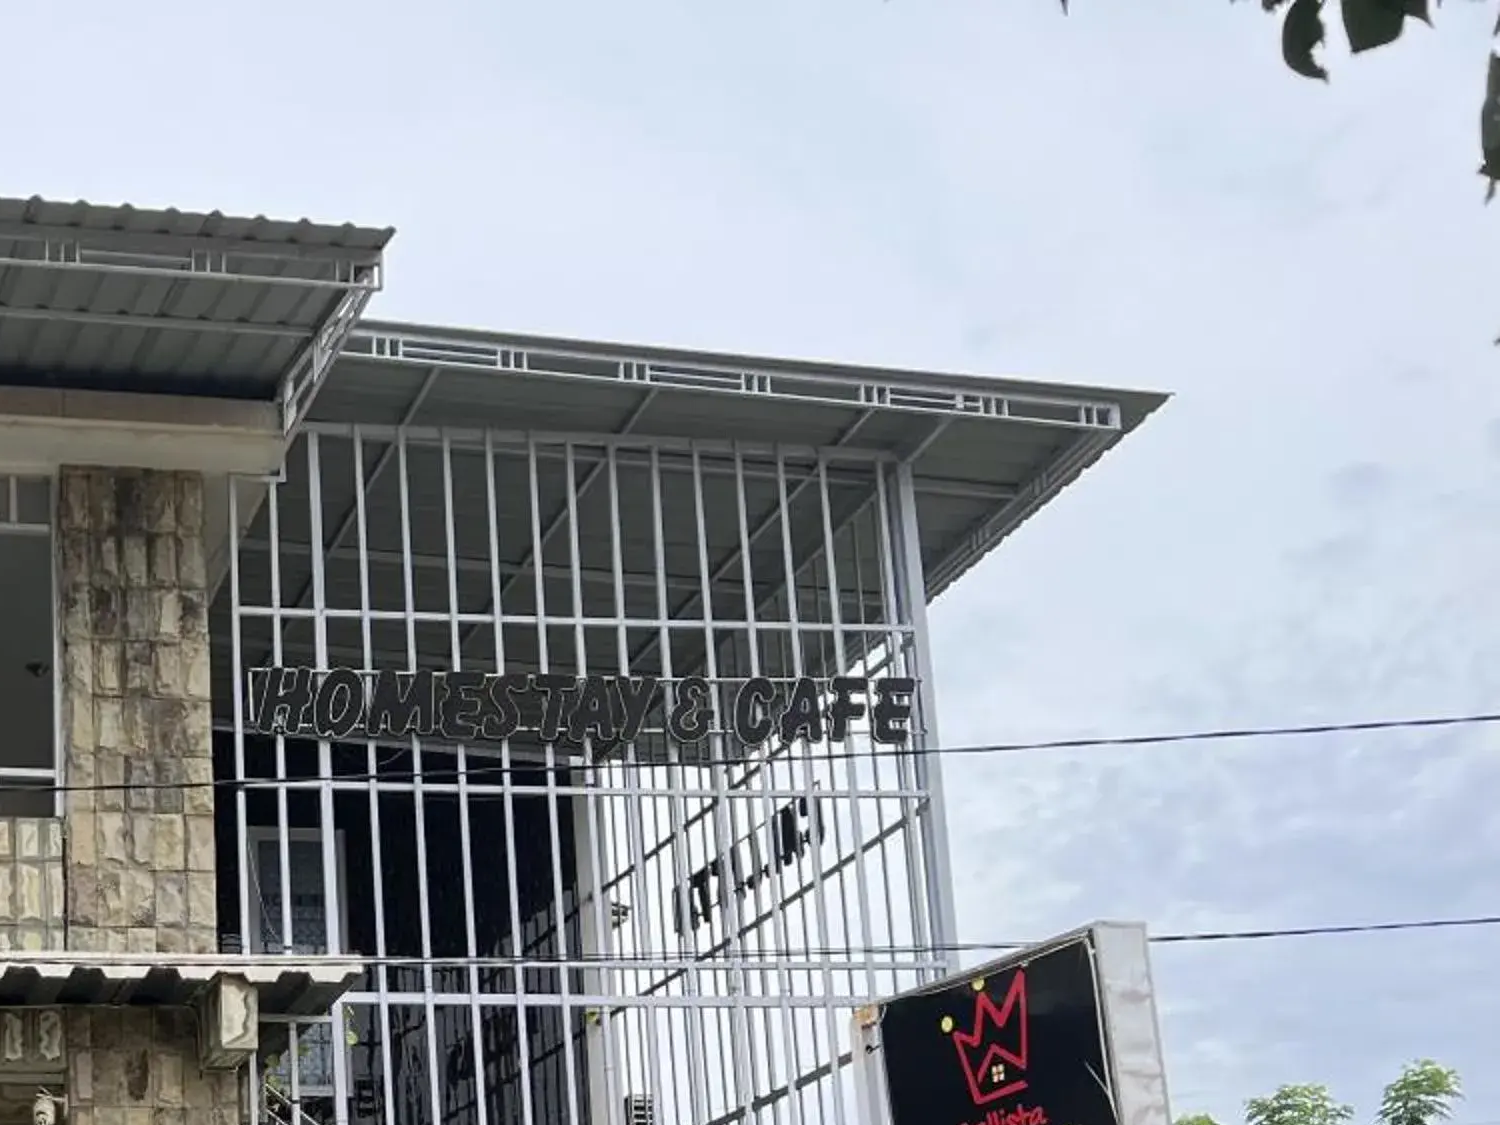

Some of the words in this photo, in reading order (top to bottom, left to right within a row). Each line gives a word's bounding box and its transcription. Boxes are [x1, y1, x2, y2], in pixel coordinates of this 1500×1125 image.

[254, 666, 658, 741] HOMESTAY
[668, 672, 717, 743] &
[732, 675, 918, 748] CAFE
